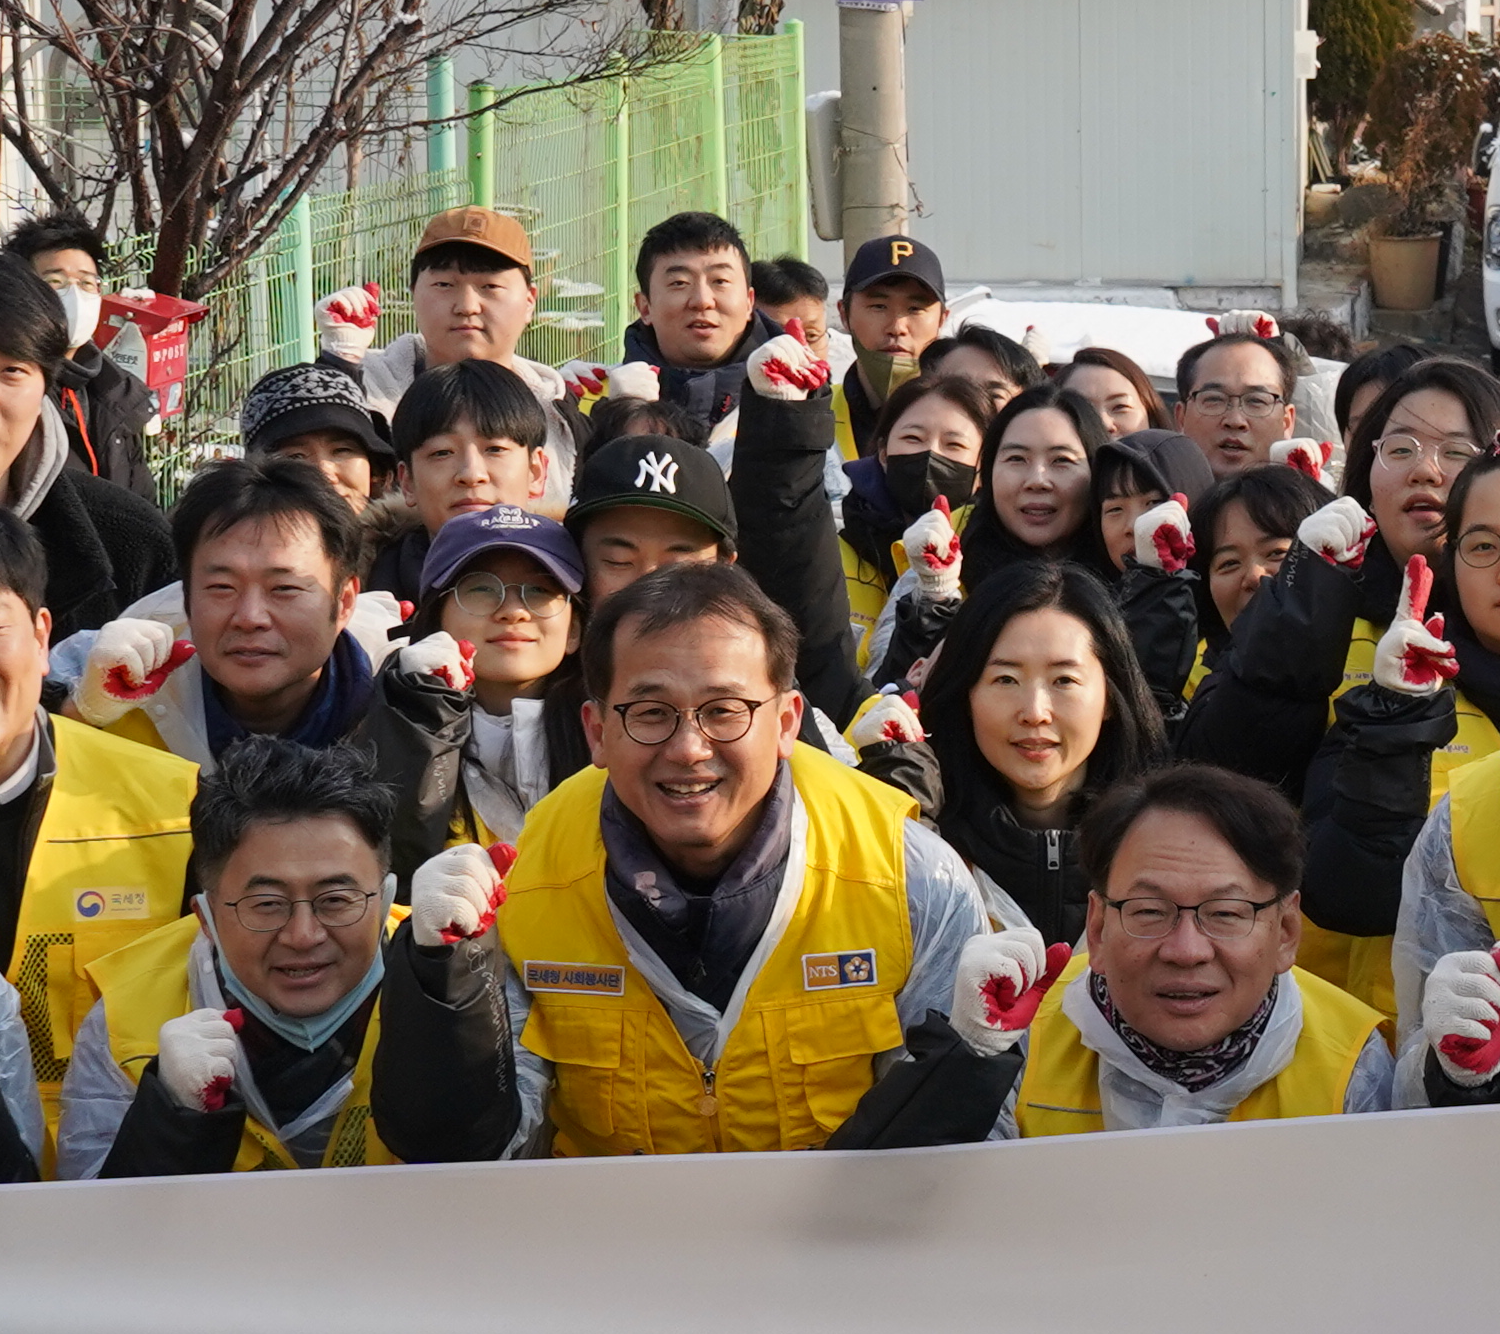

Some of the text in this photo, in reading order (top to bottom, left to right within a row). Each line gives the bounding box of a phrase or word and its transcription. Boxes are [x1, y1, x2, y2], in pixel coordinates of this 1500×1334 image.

[891, 241, 913, 265] P
[634, 451, 679, 494] NY
[110, 892, 146, 905] 국세청
[527, 969, 620, 988] 국세청 사회봉사단
[808, 965, 838, 979] NTS
